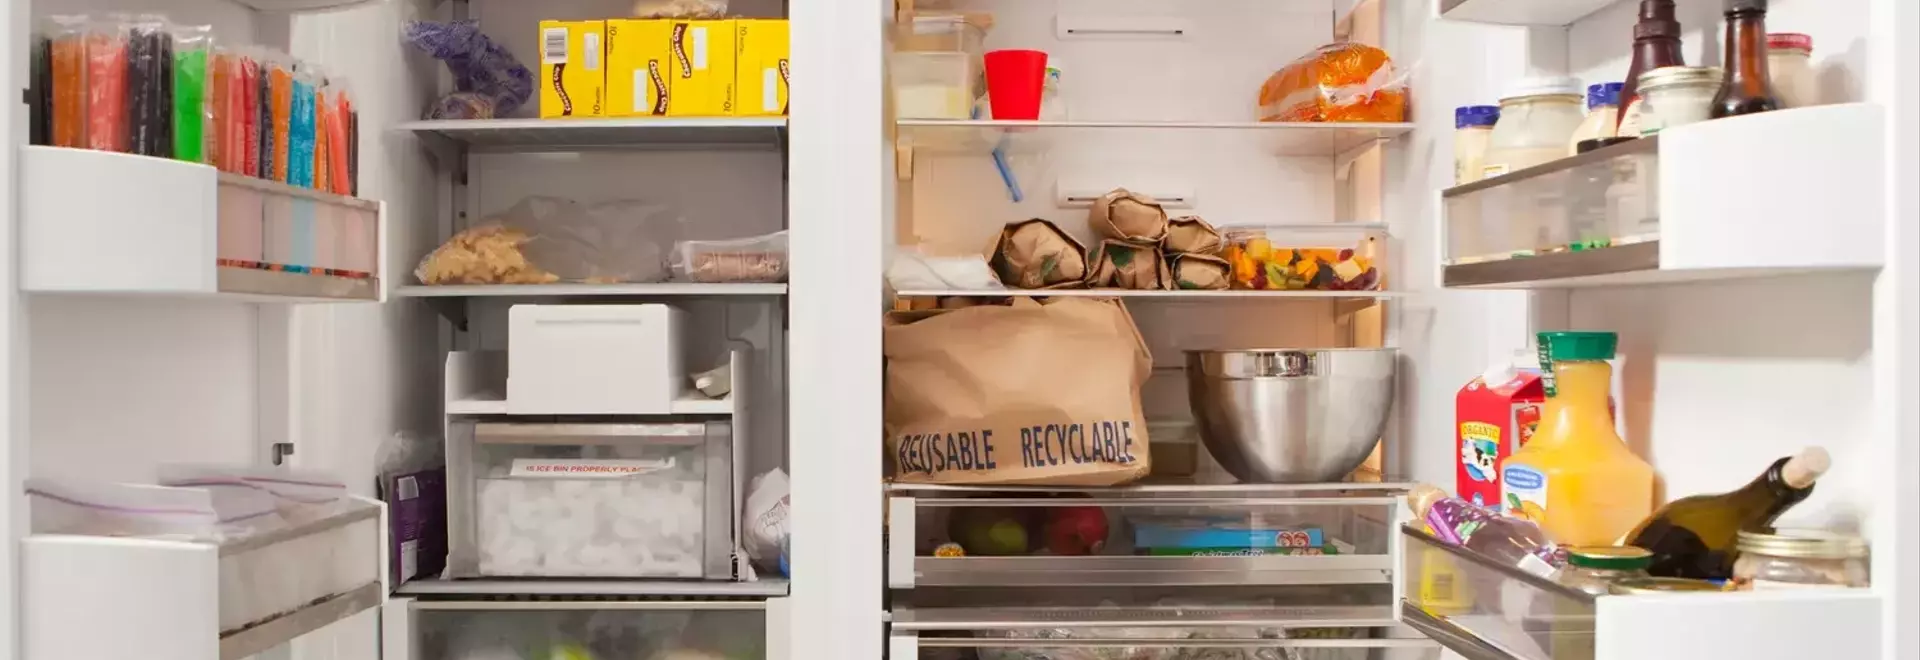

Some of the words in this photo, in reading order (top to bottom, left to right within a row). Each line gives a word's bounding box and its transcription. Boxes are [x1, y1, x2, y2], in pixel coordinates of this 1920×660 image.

[649, 61, 667, 96] Chocolate
[658, 96, 668, 113] Chip
[553, 465, 569, 473] BIN
[570, 465, 617, 473] PROPERLY
[899, 429, 997, 476] REUSABLE
[1019, 420, 1137, 469] RECYCLABLE
